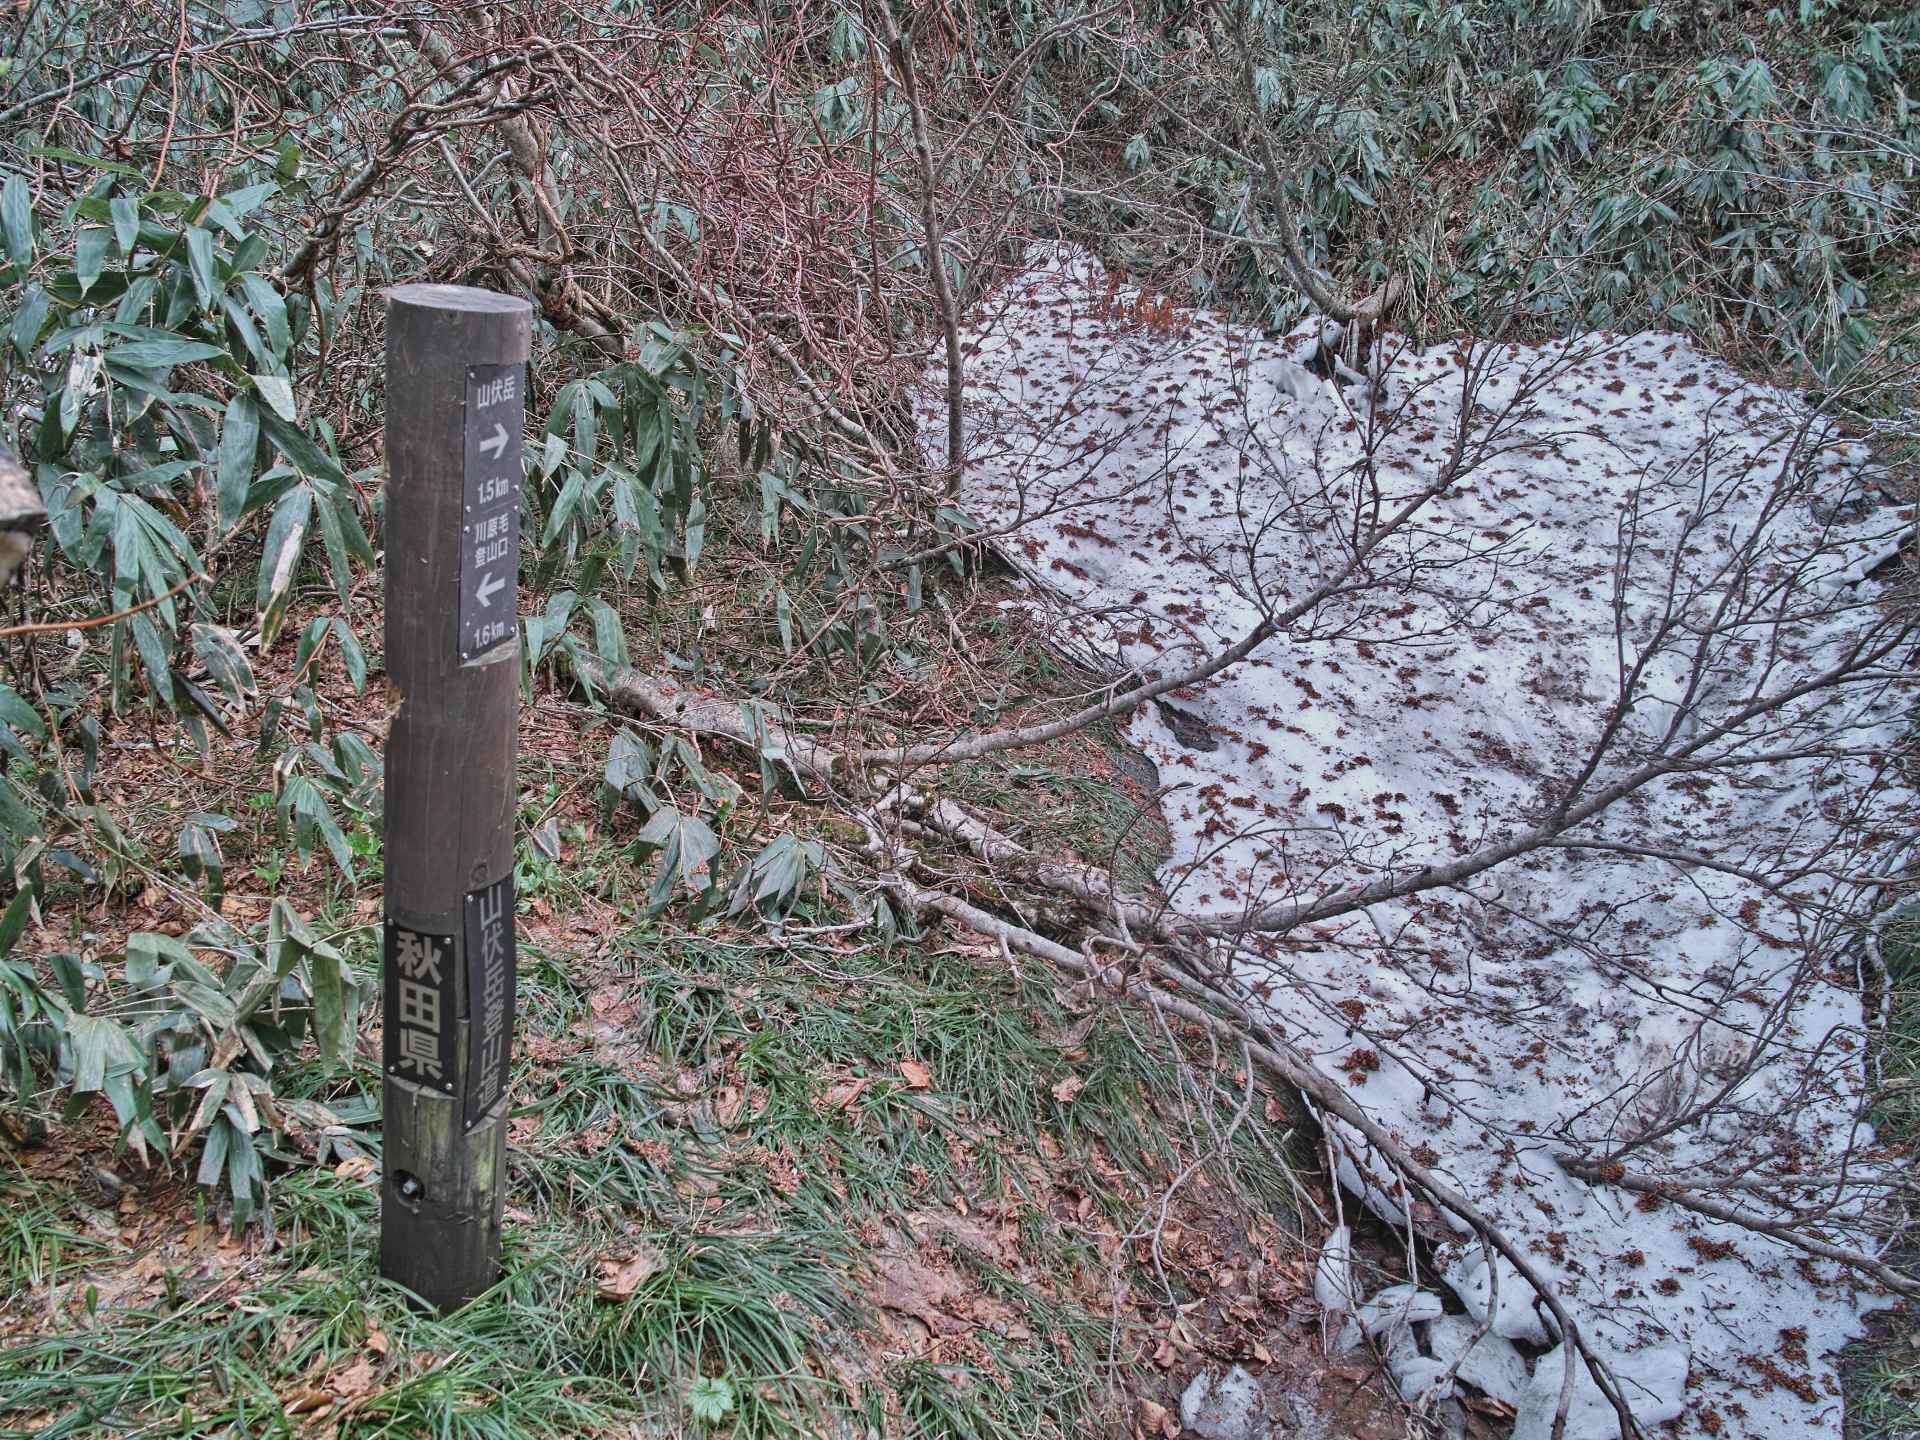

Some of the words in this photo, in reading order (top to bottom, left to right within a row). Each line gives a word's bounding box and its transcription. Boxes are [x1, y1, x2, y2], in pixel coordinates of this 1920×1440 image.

[477, 375, 515, 410] 山伏岳
[475, 513, 509, 544] 川原毛
[475, 537, 508, 568] 登山口
[397, 930, 442, 1080] 秋田県
[478, 885, 504, 1113] 山伏岳登山道
